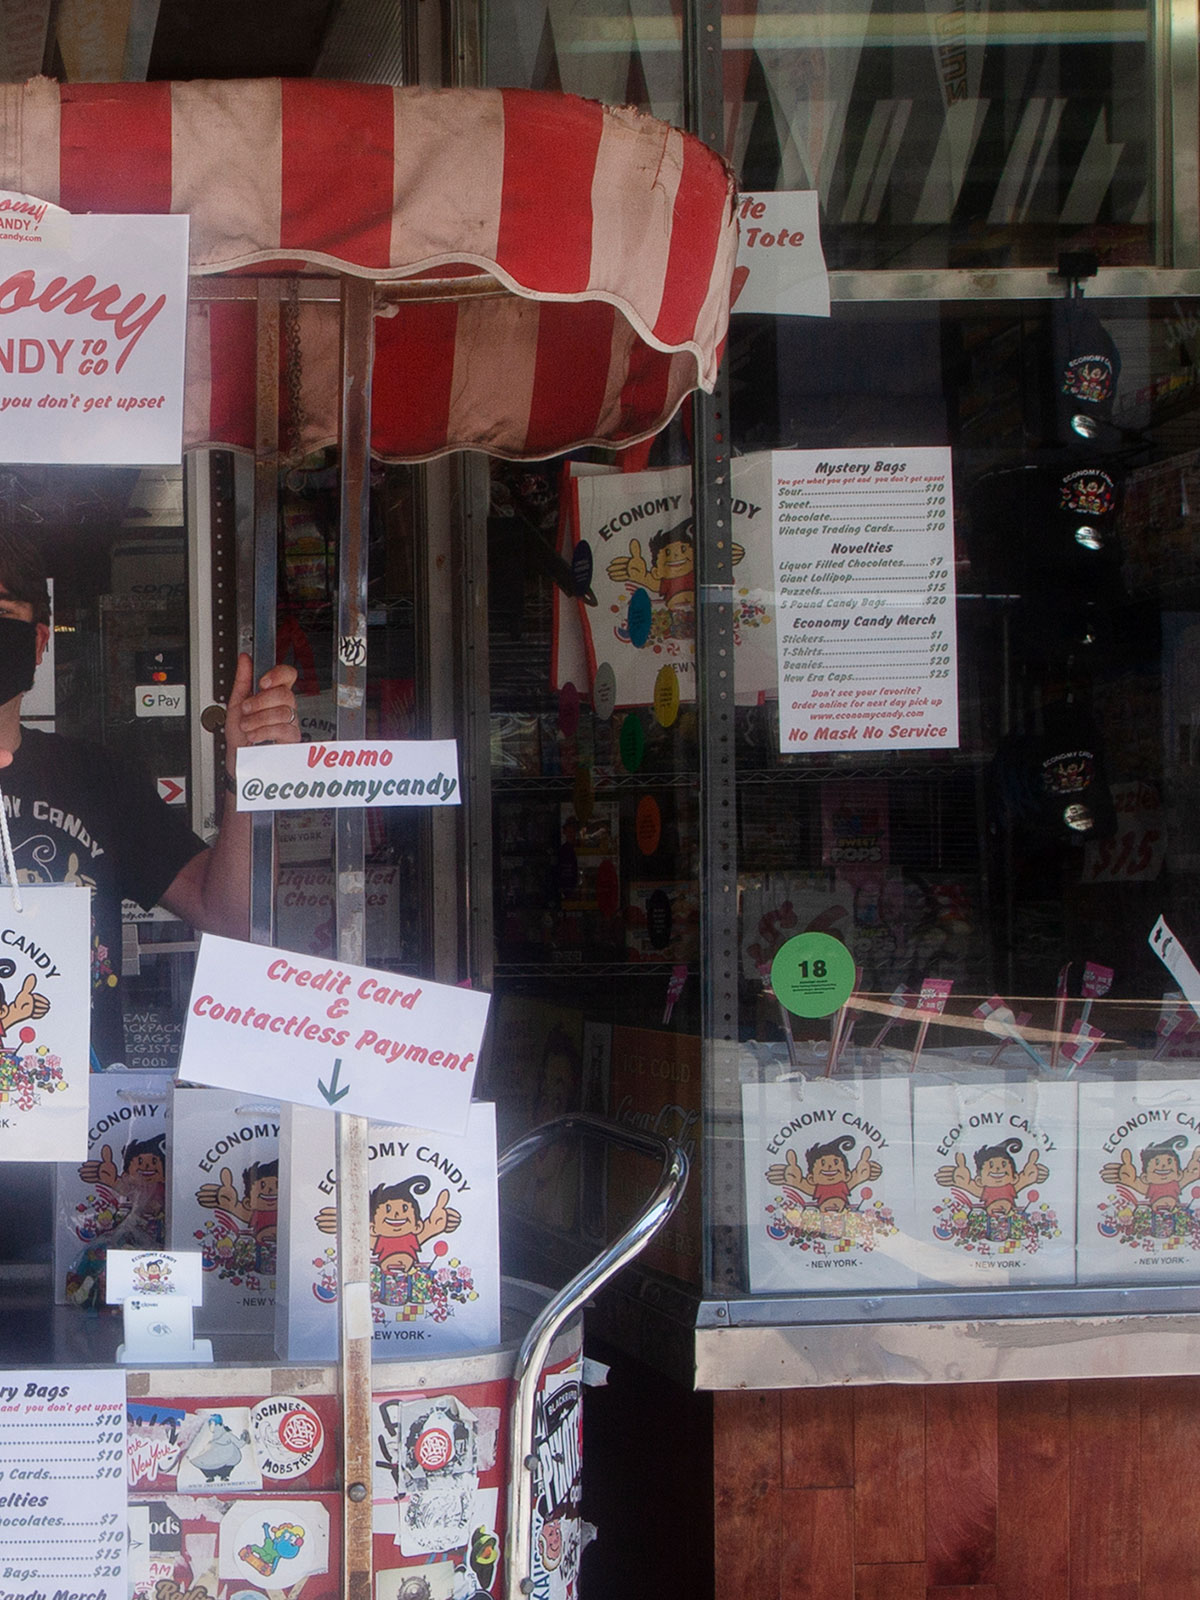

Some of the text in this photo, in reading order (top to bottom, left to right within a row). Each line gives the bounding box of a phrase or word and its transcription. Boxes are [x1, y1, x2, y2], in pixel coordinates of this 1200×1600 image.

[746, 228, 805, 248] Tote
[81, 338, 108, 357] TO
[78, 358, 109, 375] GO
[0, 397, 32, 411] you
[37, 394, 80, 408] don't
[83, 396, 112, 412] get
[117, 396, 165, 411] upset
[815, 461, 906, 476] Mystery Bags
[599, 495, 682, 541] ECONOMY
[779, 524, 861, 537] Vintage Trading
[831, 542, 893, 554] Novelties
[779, 560, 845, 572] Liquor Filled
[780, 574, 808, 583] Giant
[793, 614, 936, 630] Economy Candy Merch
[784, 673, 824, 682] New Era
[158, 694, 181, 709] Pay
[810, 710, 924, 720] www.economycandy.com
[789, 724, 947, 741] No Mask No Service
[308, 746, 392, 768] Venmo
[243, 772, 457, 803] @economycandy
[33, 800, 104, 858] CANDY
[1, 930, 60, 978] CANDY
[798, 959, 828, 979] 18
[267, 960, 422, 1009] Credit Card
[327, 998, 349, 1018] &
[193, 995, 474, 1072] Contactless Payment
[131, 1057, 169, 1067] FOOD
[767, 1110, 888, 1154] ECONOMY CANDY
[1103, 1110, 1170, 1153] ECONOMY
[199, 1124, 280, 1173] ECONOMY
[417, 1147, 470, 1192] CANDY
[812, 1259, 857, 1268] NEW YORK
[394, 1331, 424, 1340] YORK
[24, 1383, 69, 1402] Bags
